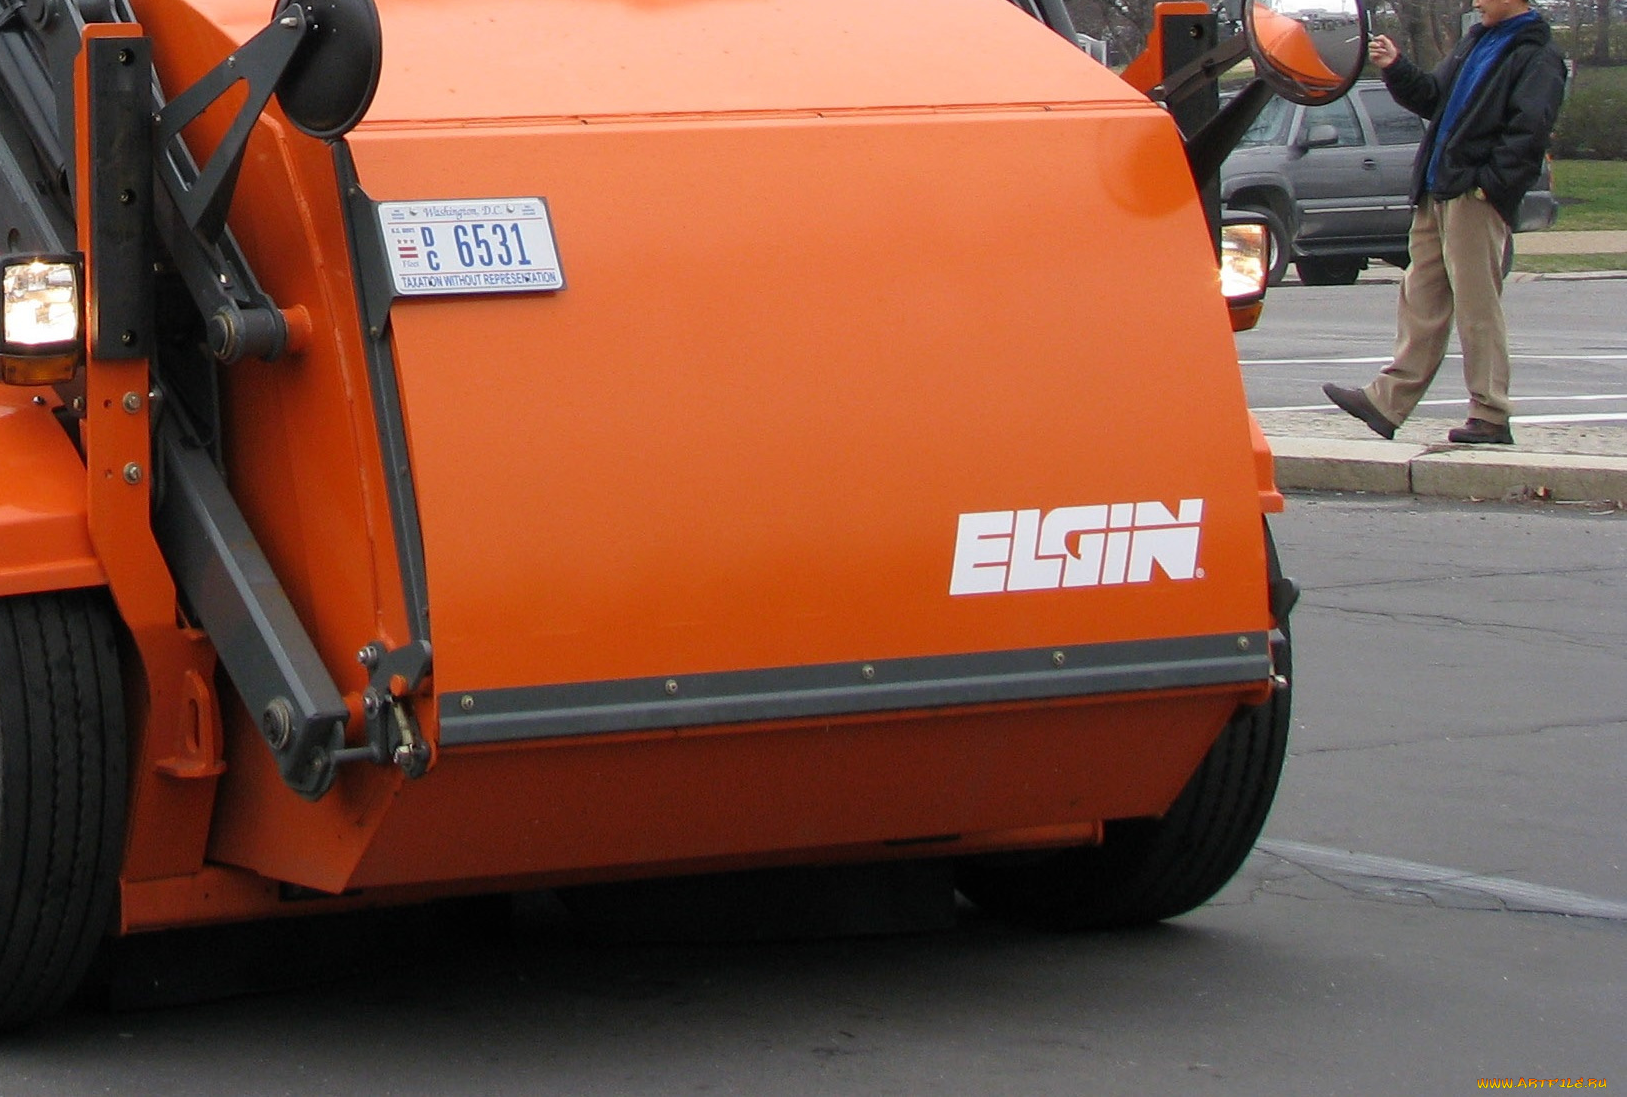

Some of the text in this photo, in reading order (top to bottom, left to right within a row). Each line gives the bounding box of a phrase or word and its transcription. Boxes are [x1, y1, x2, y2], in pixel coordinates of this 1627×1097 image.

[453, 223, 532, 268] 6531
[443, 273, 482, 287] WITHOUT
[483, 271, 557, 285] REPRESENTATION
[949, 498, 1204, 596] ELGIN
